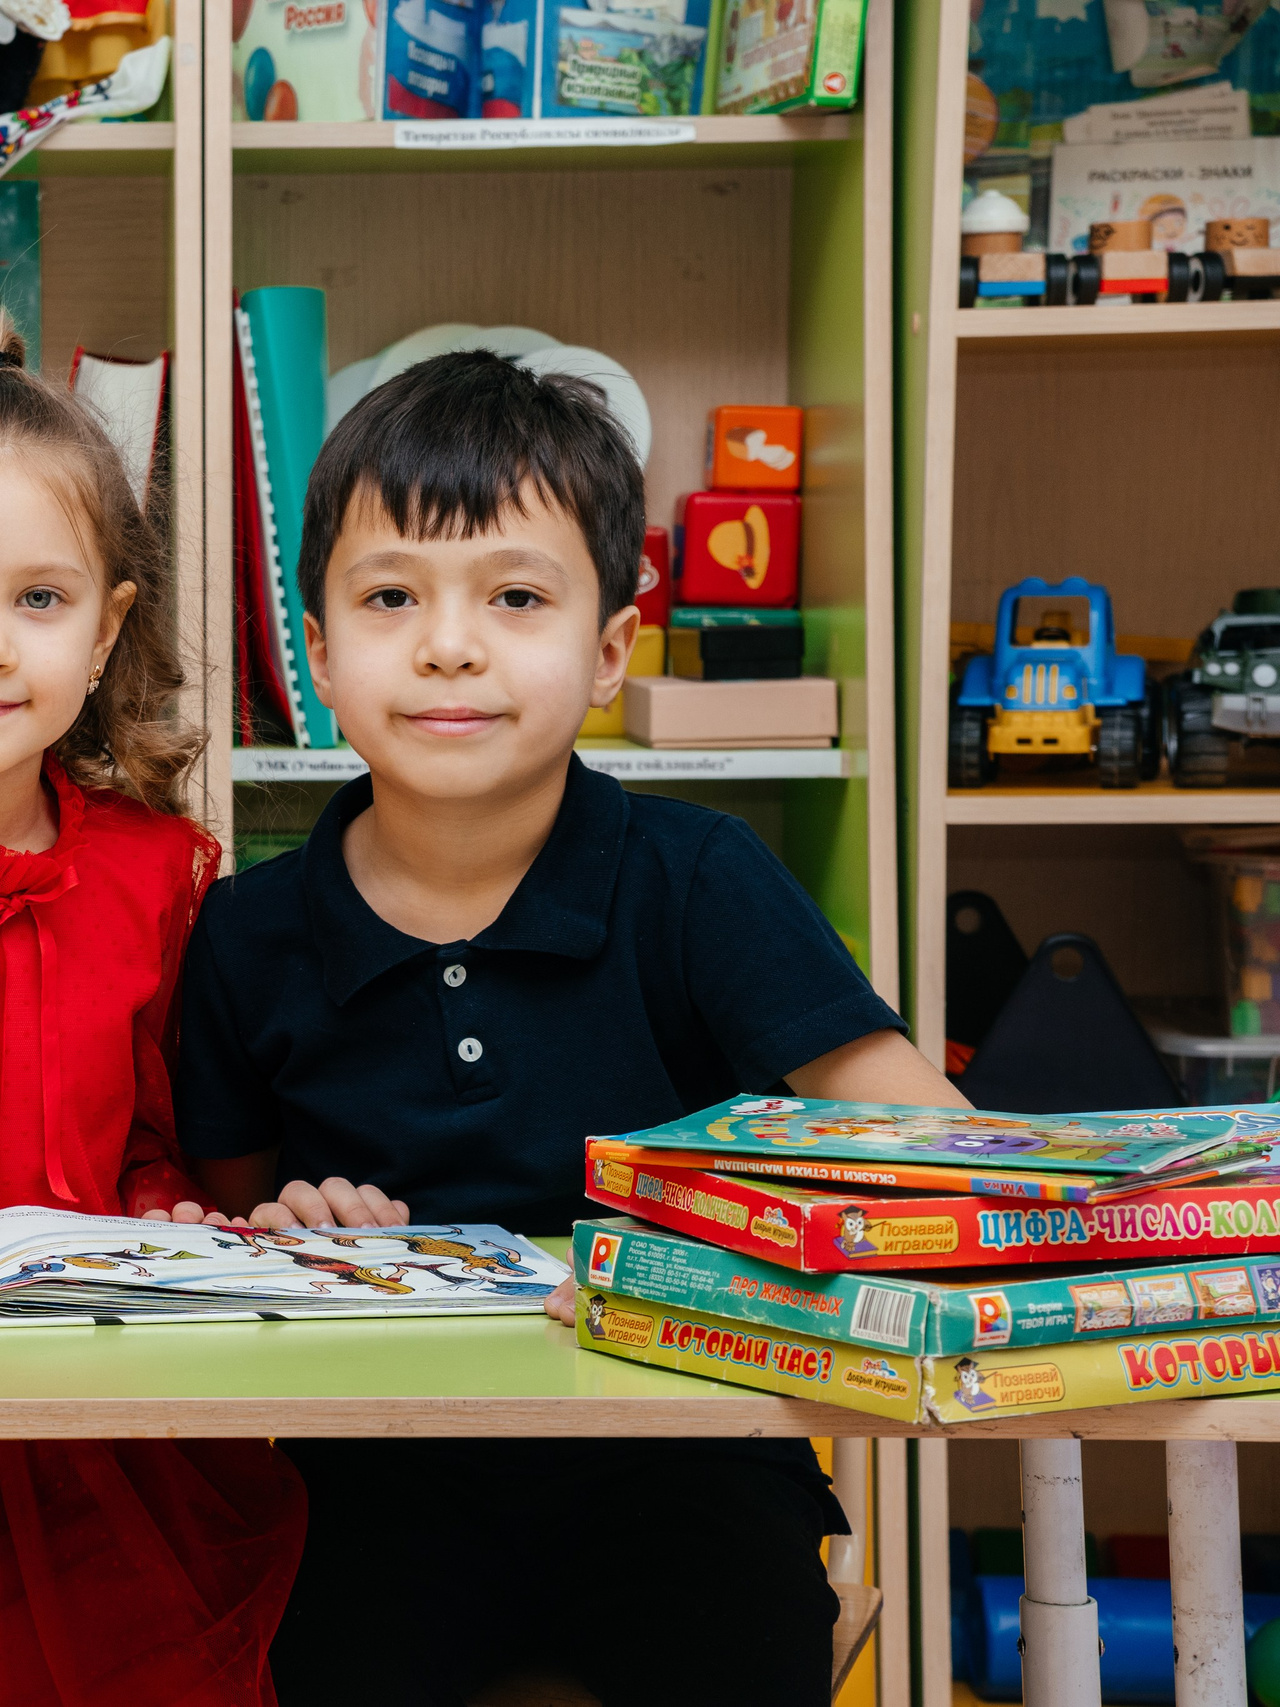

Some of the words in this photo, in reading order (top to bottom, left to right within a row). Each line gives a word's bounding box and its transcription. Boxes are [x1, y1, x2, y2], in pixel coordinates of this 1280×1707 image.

[606, 1164, 634, 1182] Познавай
[713, 1159, 784, 1176] МАЛЫШАМ
[785, 1164, 829, 1180] СТИХИ
[606, 1179, 631, 1194] играючи
[842, 1170, 897, 1185] СКАЗКИ
[879, 1220, 955, 1238] Познавай
[884, 1235, 954, 1255] играючи
[728, 1275, 759, 1298] ПРО
[758, 1282, 844, 1317] ЖИВОТНЫХ
[1035, 1301, 1064, 1317] серии
[606, 1311, 653, 1333] Познавай
[1016, 1315, 1045, 1331] "ТВОЯ
[607, 1328, 649, 1346] играючи
[660, 1316, 771, 1369] КОТОРЫЙ
[773, 1342, 835, 1384] ЧАС?
[992, 1367, 1059, 1389] Познавай
[999, 1385, 1062, 1406] играючи
